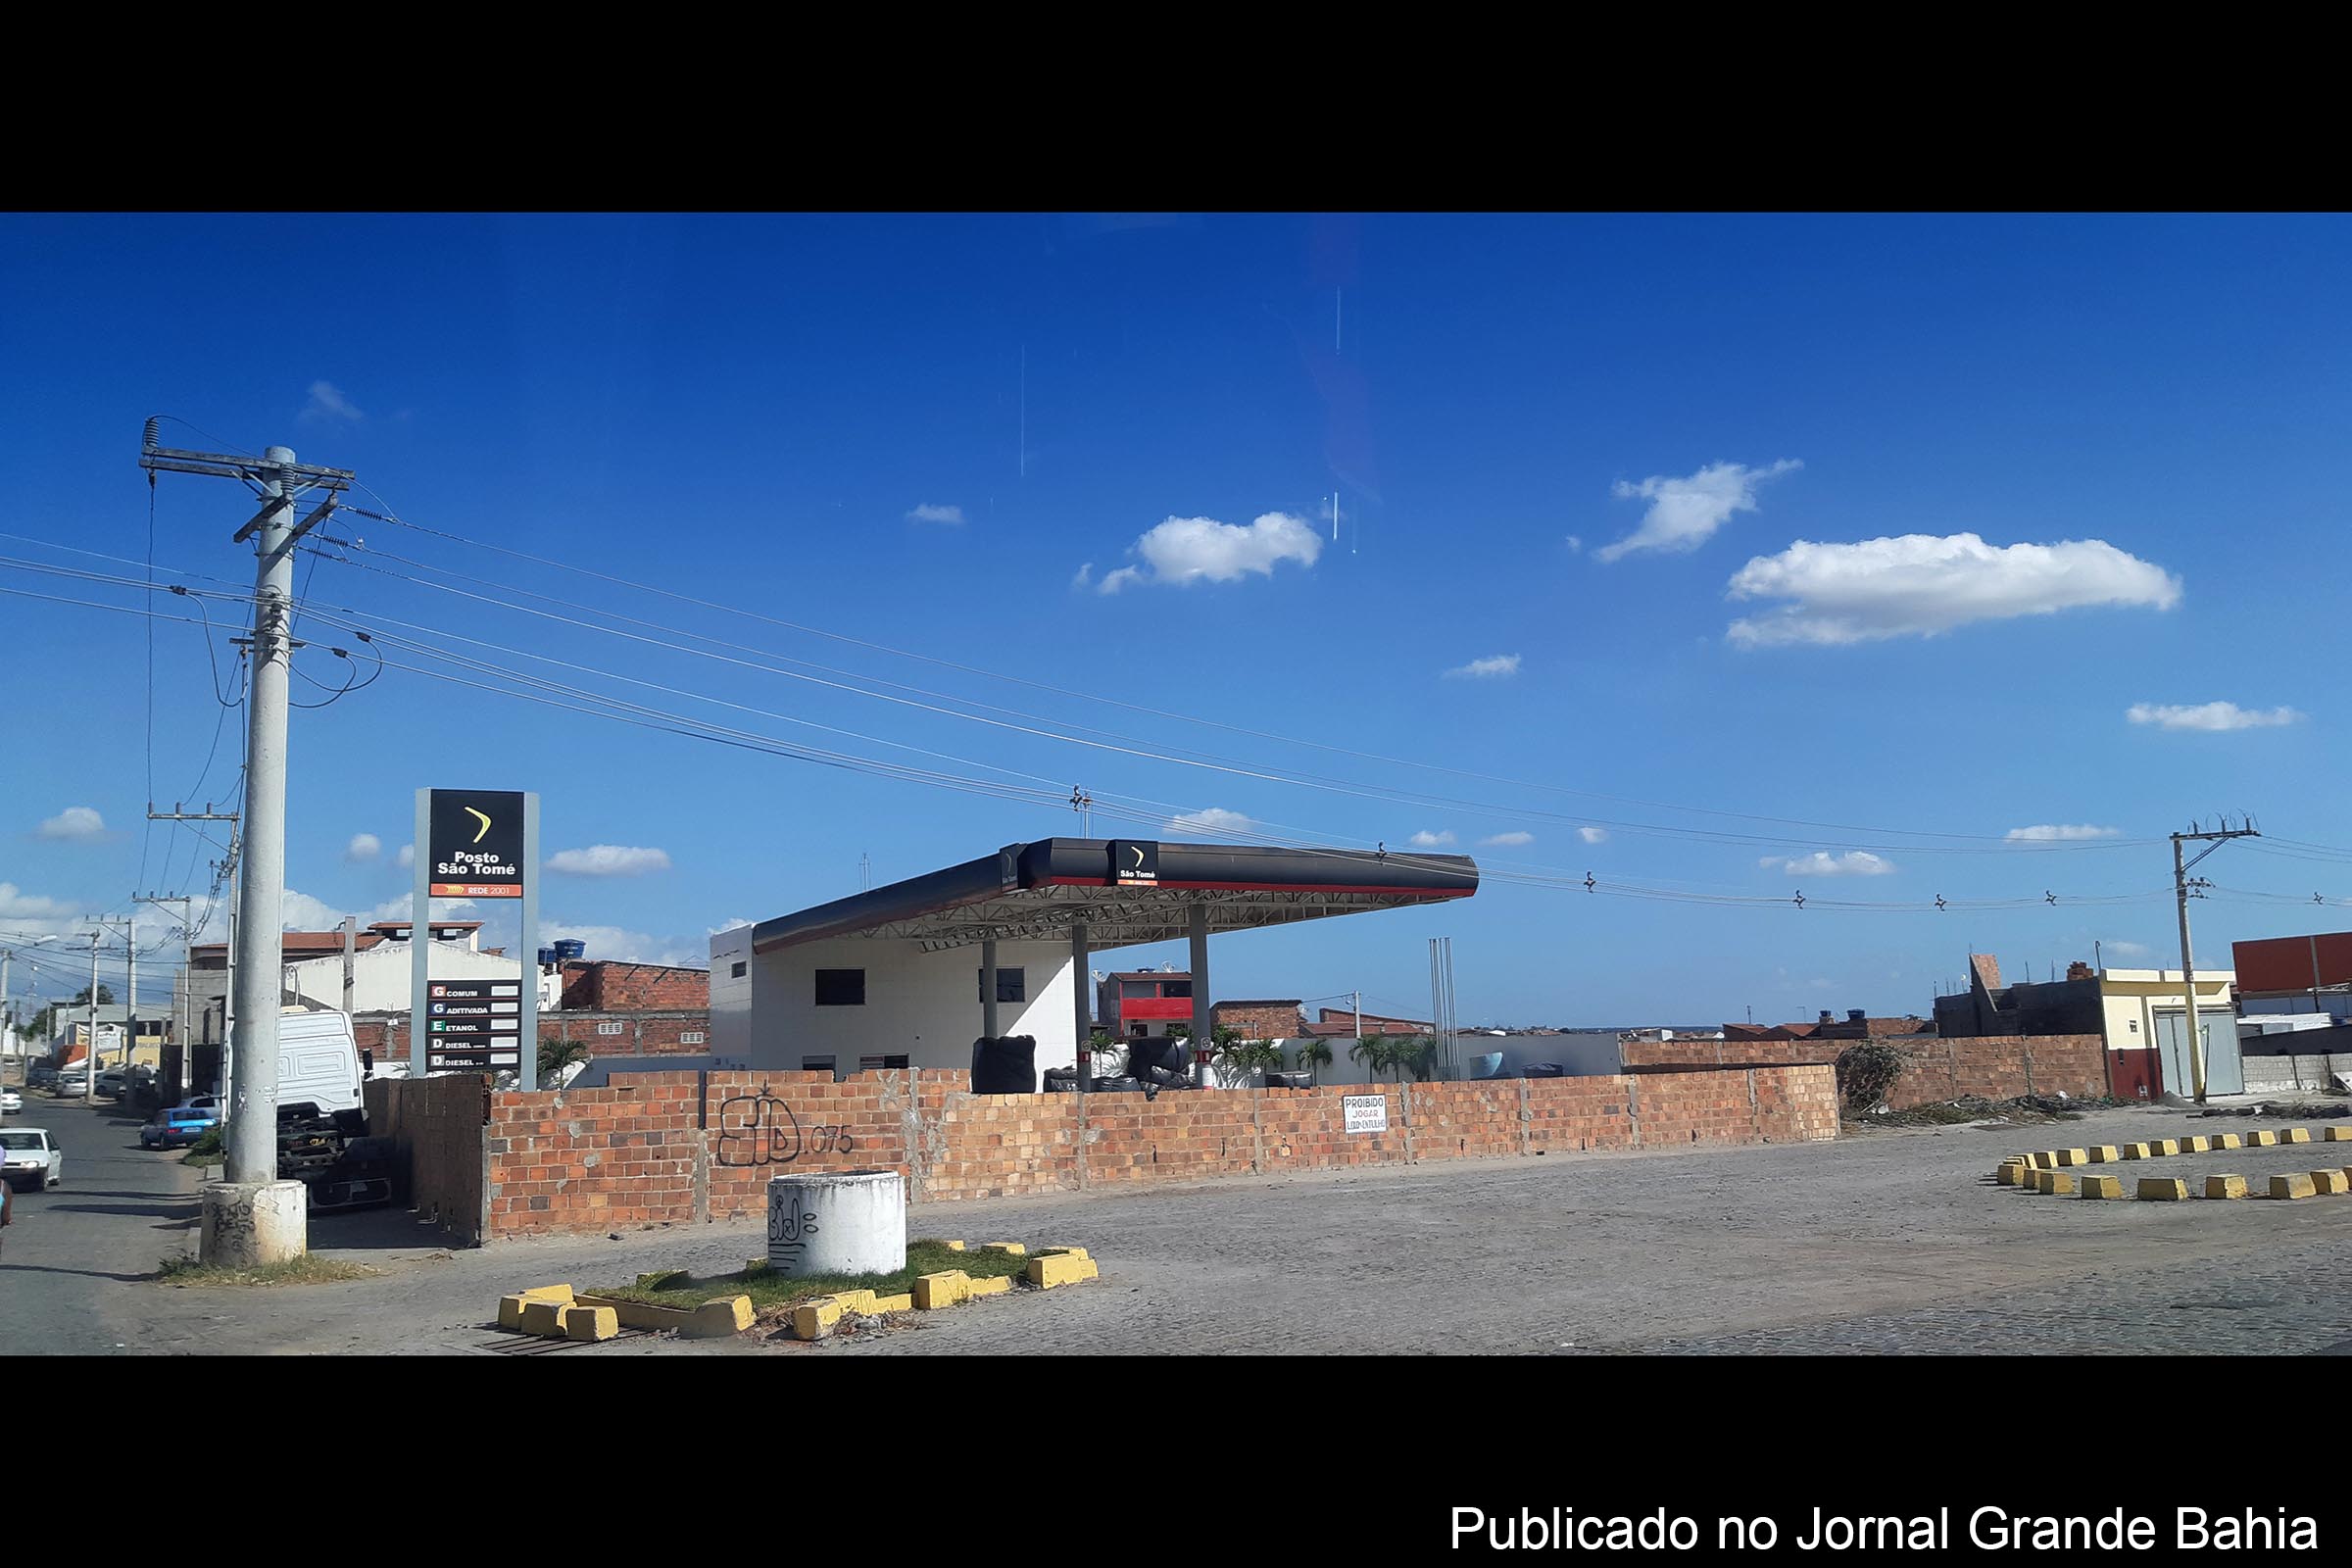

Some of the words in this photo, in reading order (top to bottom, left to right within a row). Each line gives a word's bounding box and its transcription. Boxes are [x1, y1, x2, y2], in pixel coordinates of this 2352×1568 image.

[455, 851, 500, 863] Posto
[437, 862, 468, 874] São
[472, 863, 516, 875] Tomé
[1120, 869, 1135, 878] São
[1136, 870, 1155, 879] Tomé
[433, 987, 445, 997] G
[433, 1004, 444, 1013] G
[446, 1006, 488, 1015] ADITIVADA
[433, 1020, 443, 1031] E
[432, 1038, 443, 1049] D
[433, 1055, 442, 1066] D
[1346, 1097, 1384, 1108] PROIBIDO
[1352, 1109, 1379, 1118] JOGAR
